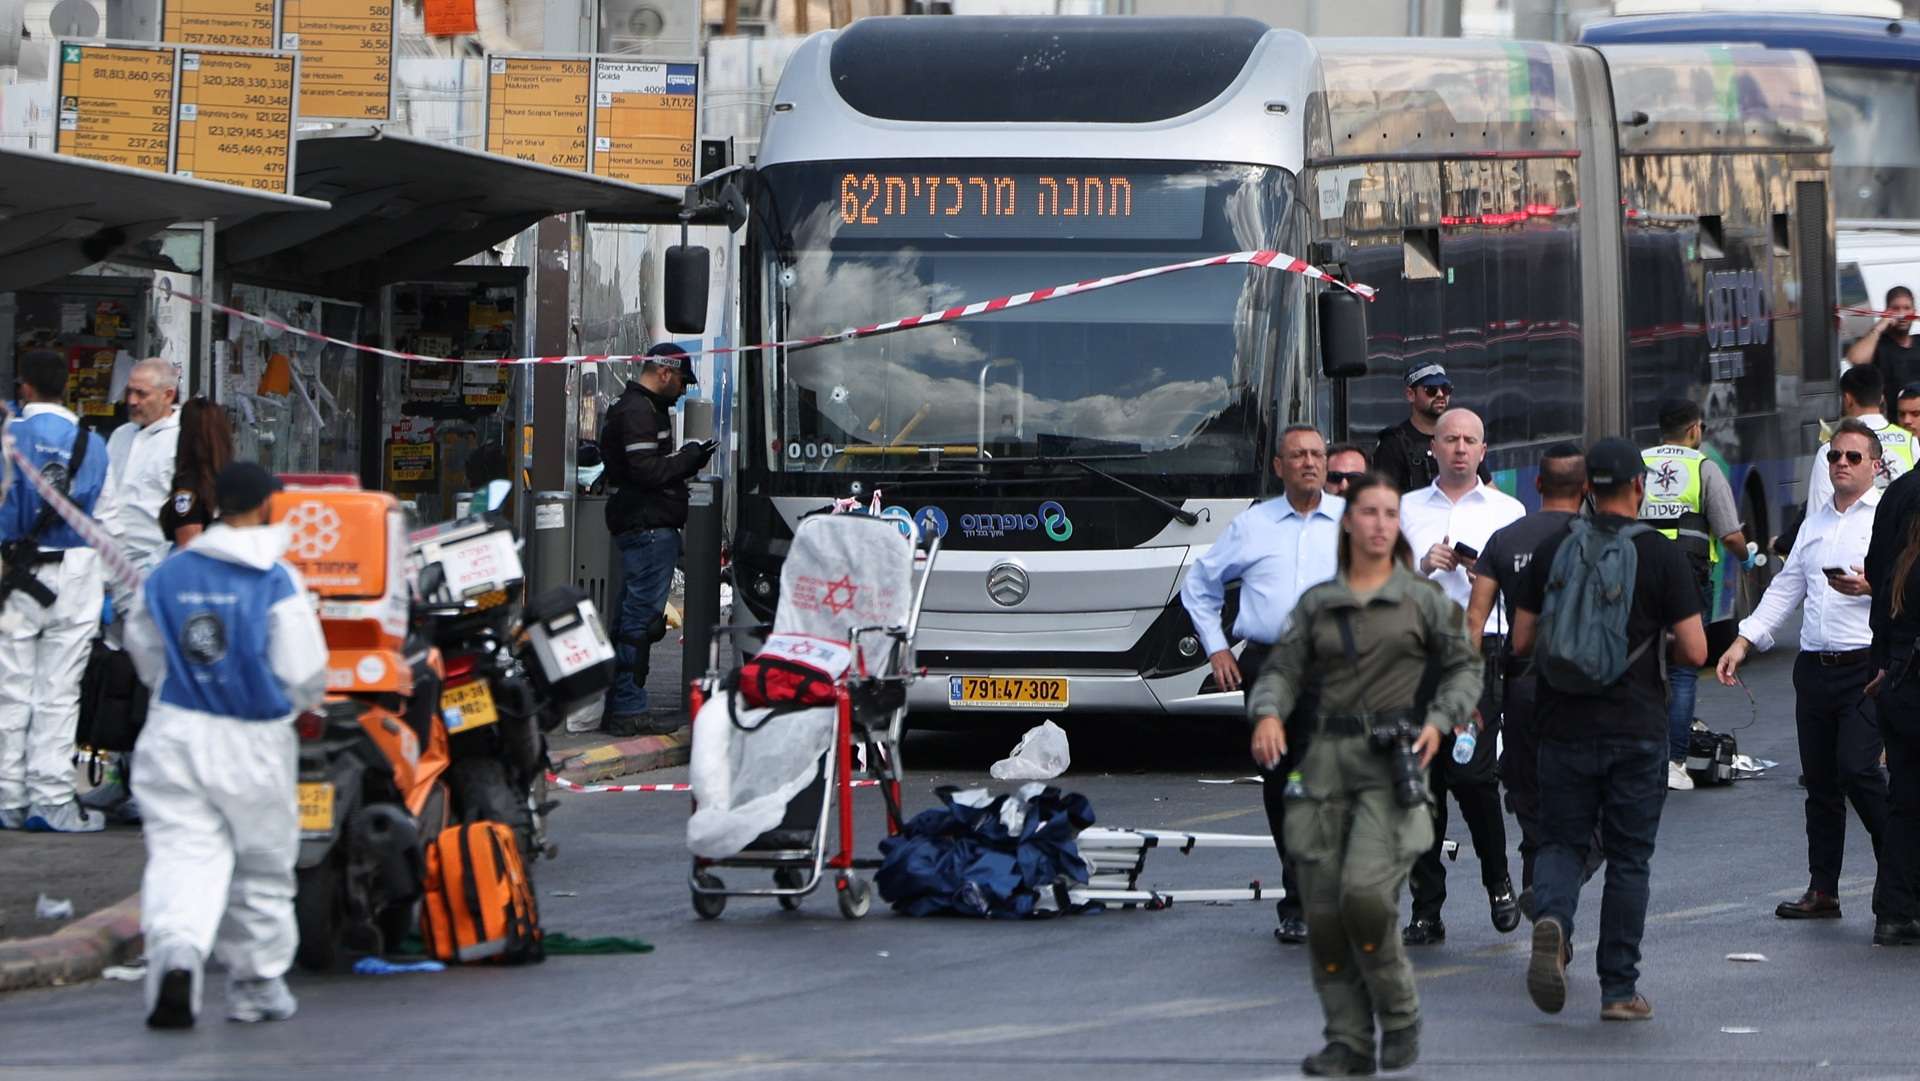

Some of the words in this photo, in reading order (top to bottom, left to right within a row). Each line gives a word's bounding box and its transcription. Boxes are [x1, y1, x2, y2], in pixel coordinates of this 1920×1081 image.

[369, 6, 390, 16] 580
[598, 63, 625, 71] Ramot
[680, 143, 692, 152] 62
[841, 174, 879, 224] 62
[884, 177, 1015, 216] מרכזית
[1038, 177, 1132, 216] תחנה
